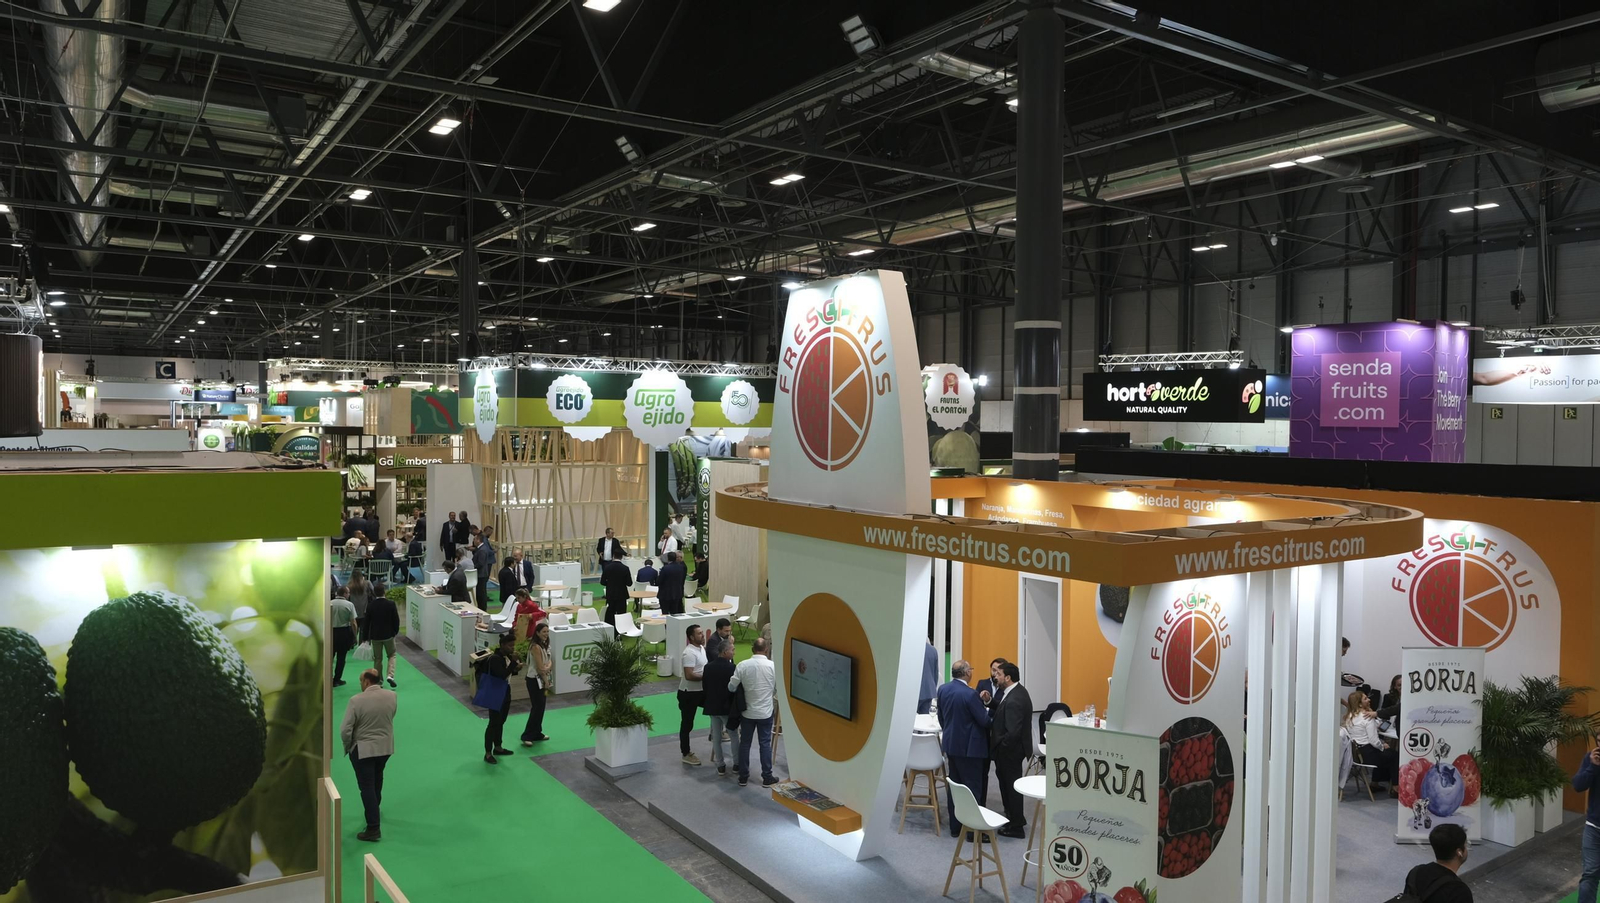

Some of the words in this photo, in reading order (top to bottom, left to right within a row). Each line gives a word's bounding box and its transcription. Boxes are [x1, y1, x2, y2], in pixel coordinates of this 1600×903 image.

[779, 298, 892, 396] FRESCITRUS
[160, 364, 173, 378] C
[1329, 358, 1392, 376] senda
[1437, 366, 1448, 384] Join
[1331, 381, 1388, 399] fruits
[1572, 377, 1585, 386] for
[1588, 378, 1600, 388] pa
[555, 393, 584, 411] ECO
[1437, 389, 1447, 407] The
[1447, 390, 1461, 412] Berry
[479, 406, 495, 424] ejido
[642, 407, 685, 428] ejido
[1126, 406, 1156, 414] NATURAL
[1157, 406, 1188, 414] QUALITY
[1333, 407, 1385, 420] .com
[1436, 413, 1463, 431] Movement
[981, 503, 1005, 513] Naranja,
[1044, 509, 1065, 520] Fresa,
[864, 526, 1071, 573] www.frescitrus.com
[1174, 536, 1365, 575] www.frescitrus.com
[1391, 533, 1540, 610] FRESCITRUS
[1150, 592, 1232, 660] FRESCITRUS
[1408, 668, 1477, 694] BORJA
[1411, 717, 1441, 728] grandes
[1408, 733, 1430, 747] 50
[1106, 751, 1124, 760] 1975
[1053, 757, 1147, 804] BORJA
[1077, 810, 1124, 827] Pequeños
[1057, 826, 1098, 836] grandes
[1053, 842, 1083, 866] 50
[1059, 864, 1075, 872] AÑOS
